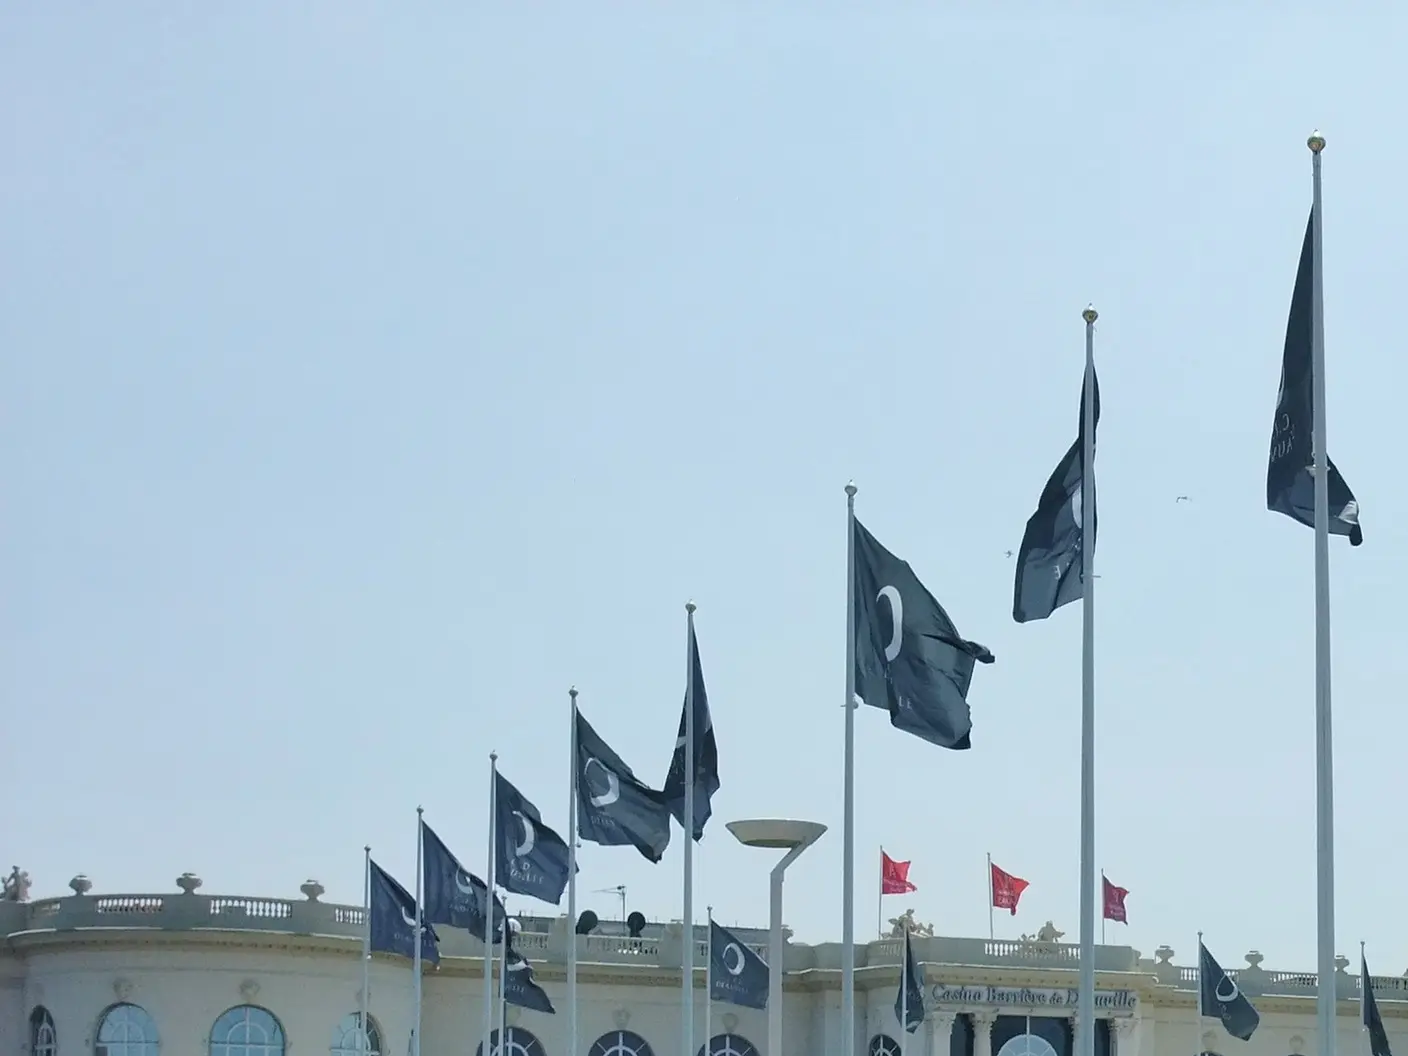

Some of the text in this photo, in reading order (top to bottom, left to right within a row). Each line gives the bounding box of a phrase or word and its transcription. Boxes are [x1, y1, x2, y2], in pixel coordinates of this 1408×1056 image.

[931, 984, 982, 1001] Casino
[986, 986, 1046, 1005] Barrière
[1048, 991, 1063, 1005] de
